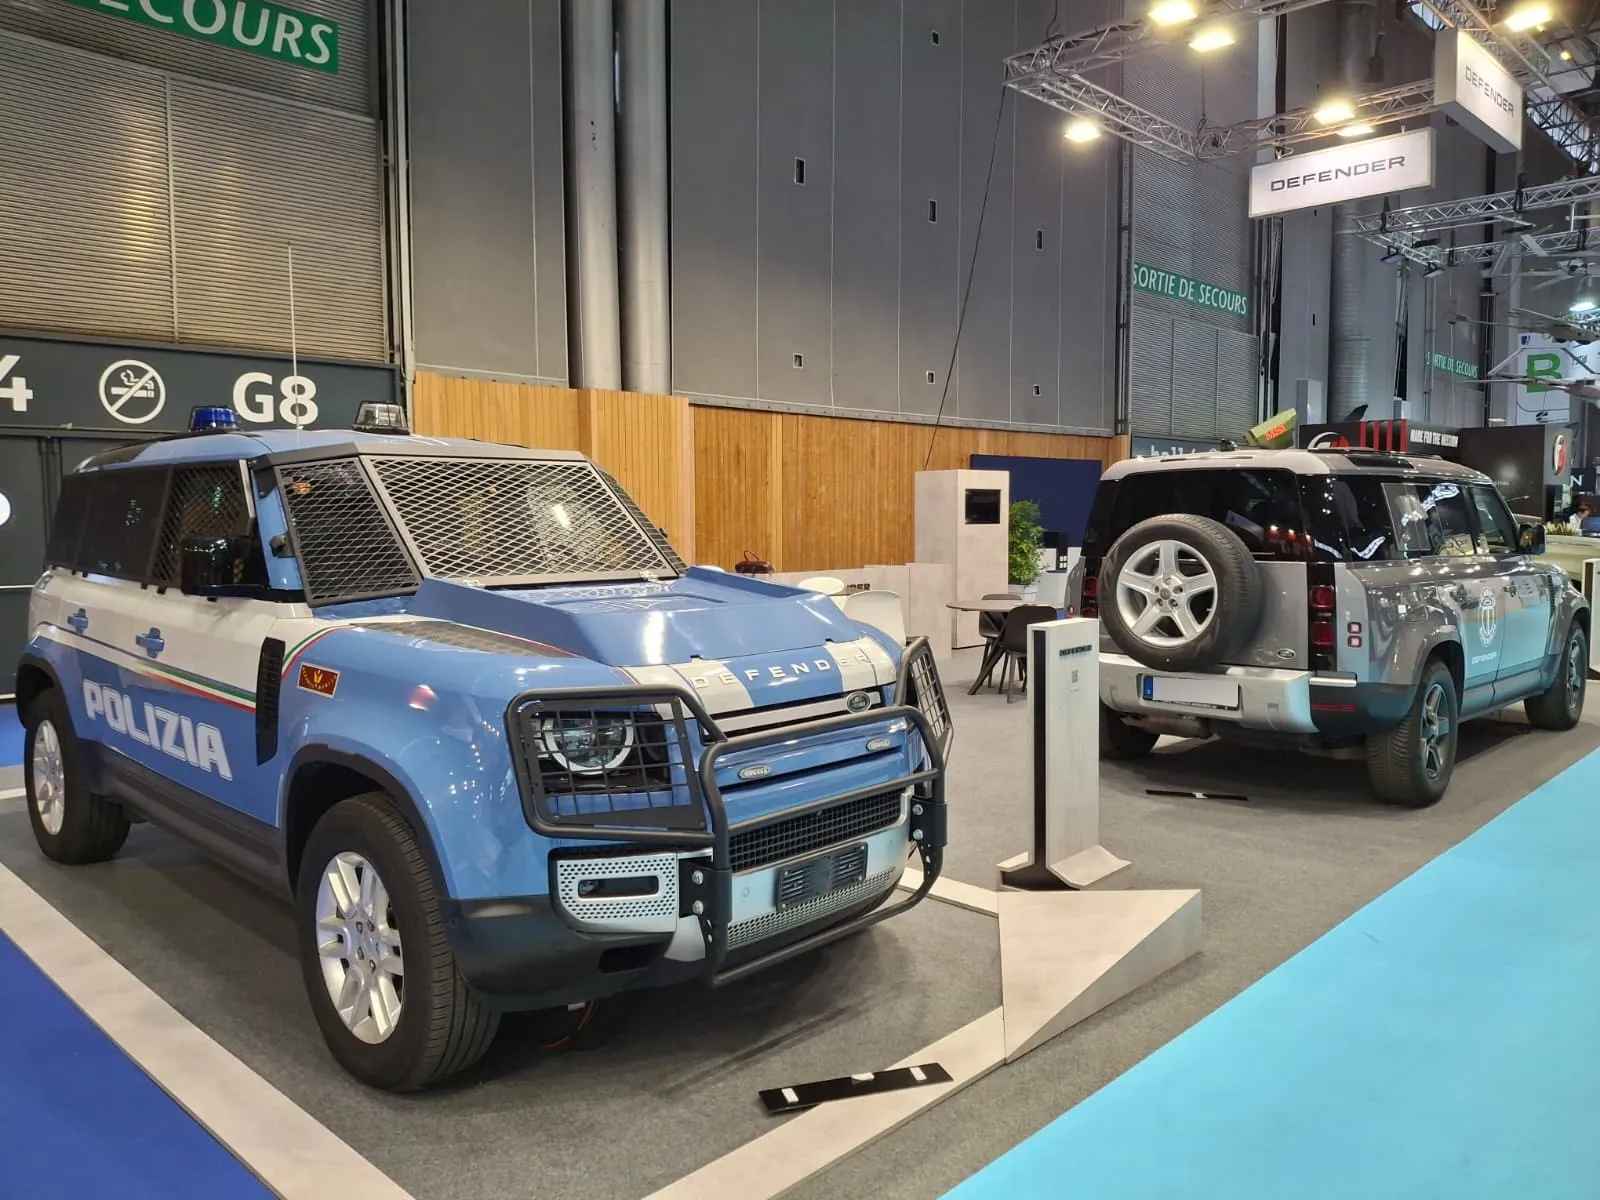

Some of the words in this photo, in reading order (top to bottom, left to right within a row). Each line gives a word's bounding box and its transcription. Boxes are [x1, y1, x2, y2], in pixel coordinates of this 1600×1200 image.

[98, 0, 333, 64] COURS
[1465, 64, 1514, 118] DEFENDER
[1270, 155, 1406, 192] DEFENDER
[1132, 263, 1176, 295] SORTIE
[1179, 278, 1196, 300] DE
[1198, 284, 1247, 314] SECOURS
[233, 372, 318, 425] G8
[690, 656, 871, 689] DEFENDER
[83, 679, 233, 782] POLIZIA
